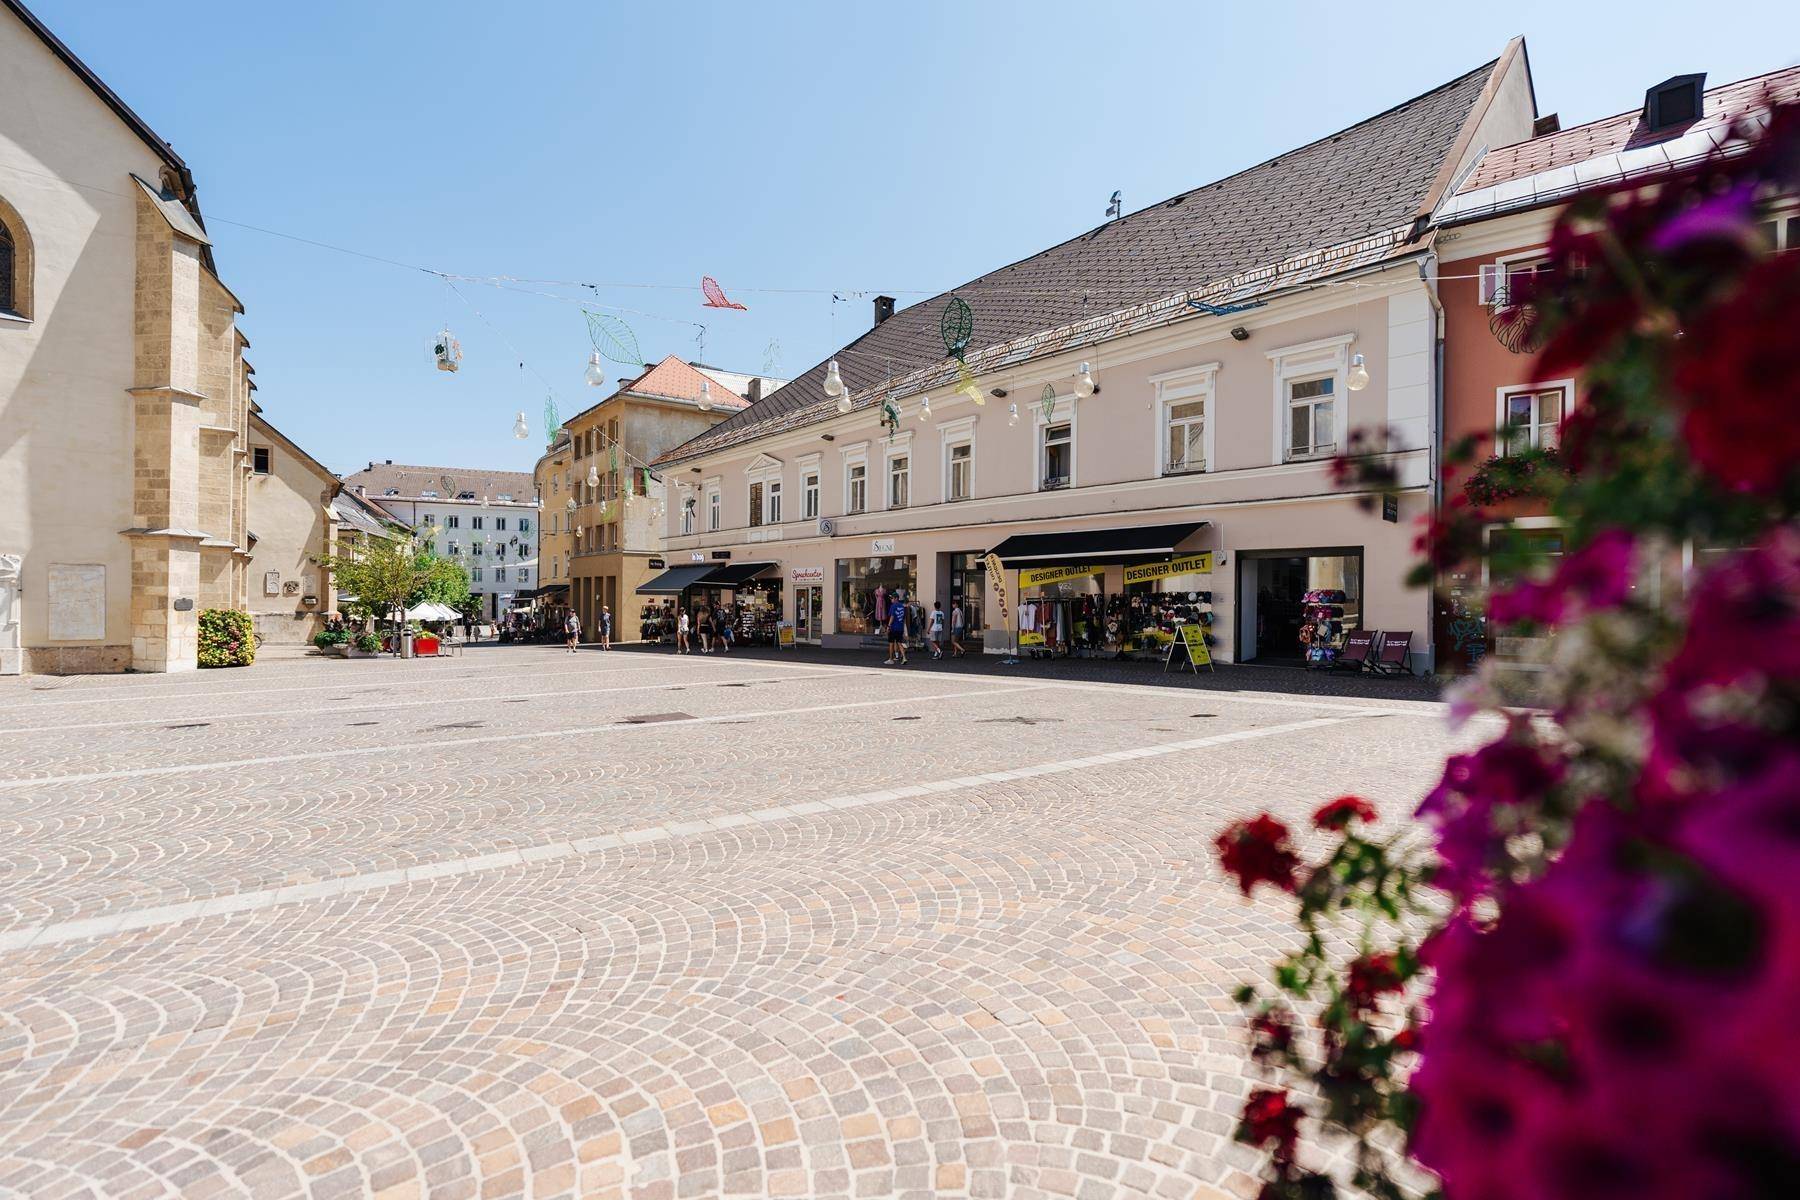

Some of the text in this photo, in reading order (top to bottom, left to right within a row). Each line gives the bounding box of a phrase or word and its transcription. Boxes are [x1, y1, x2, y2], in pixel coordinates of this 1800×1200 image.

[1030, 565, 1091, 582] DESIGNER OUTLET
[1127, 558, 1206, 580] DESIGNER OUTLET
